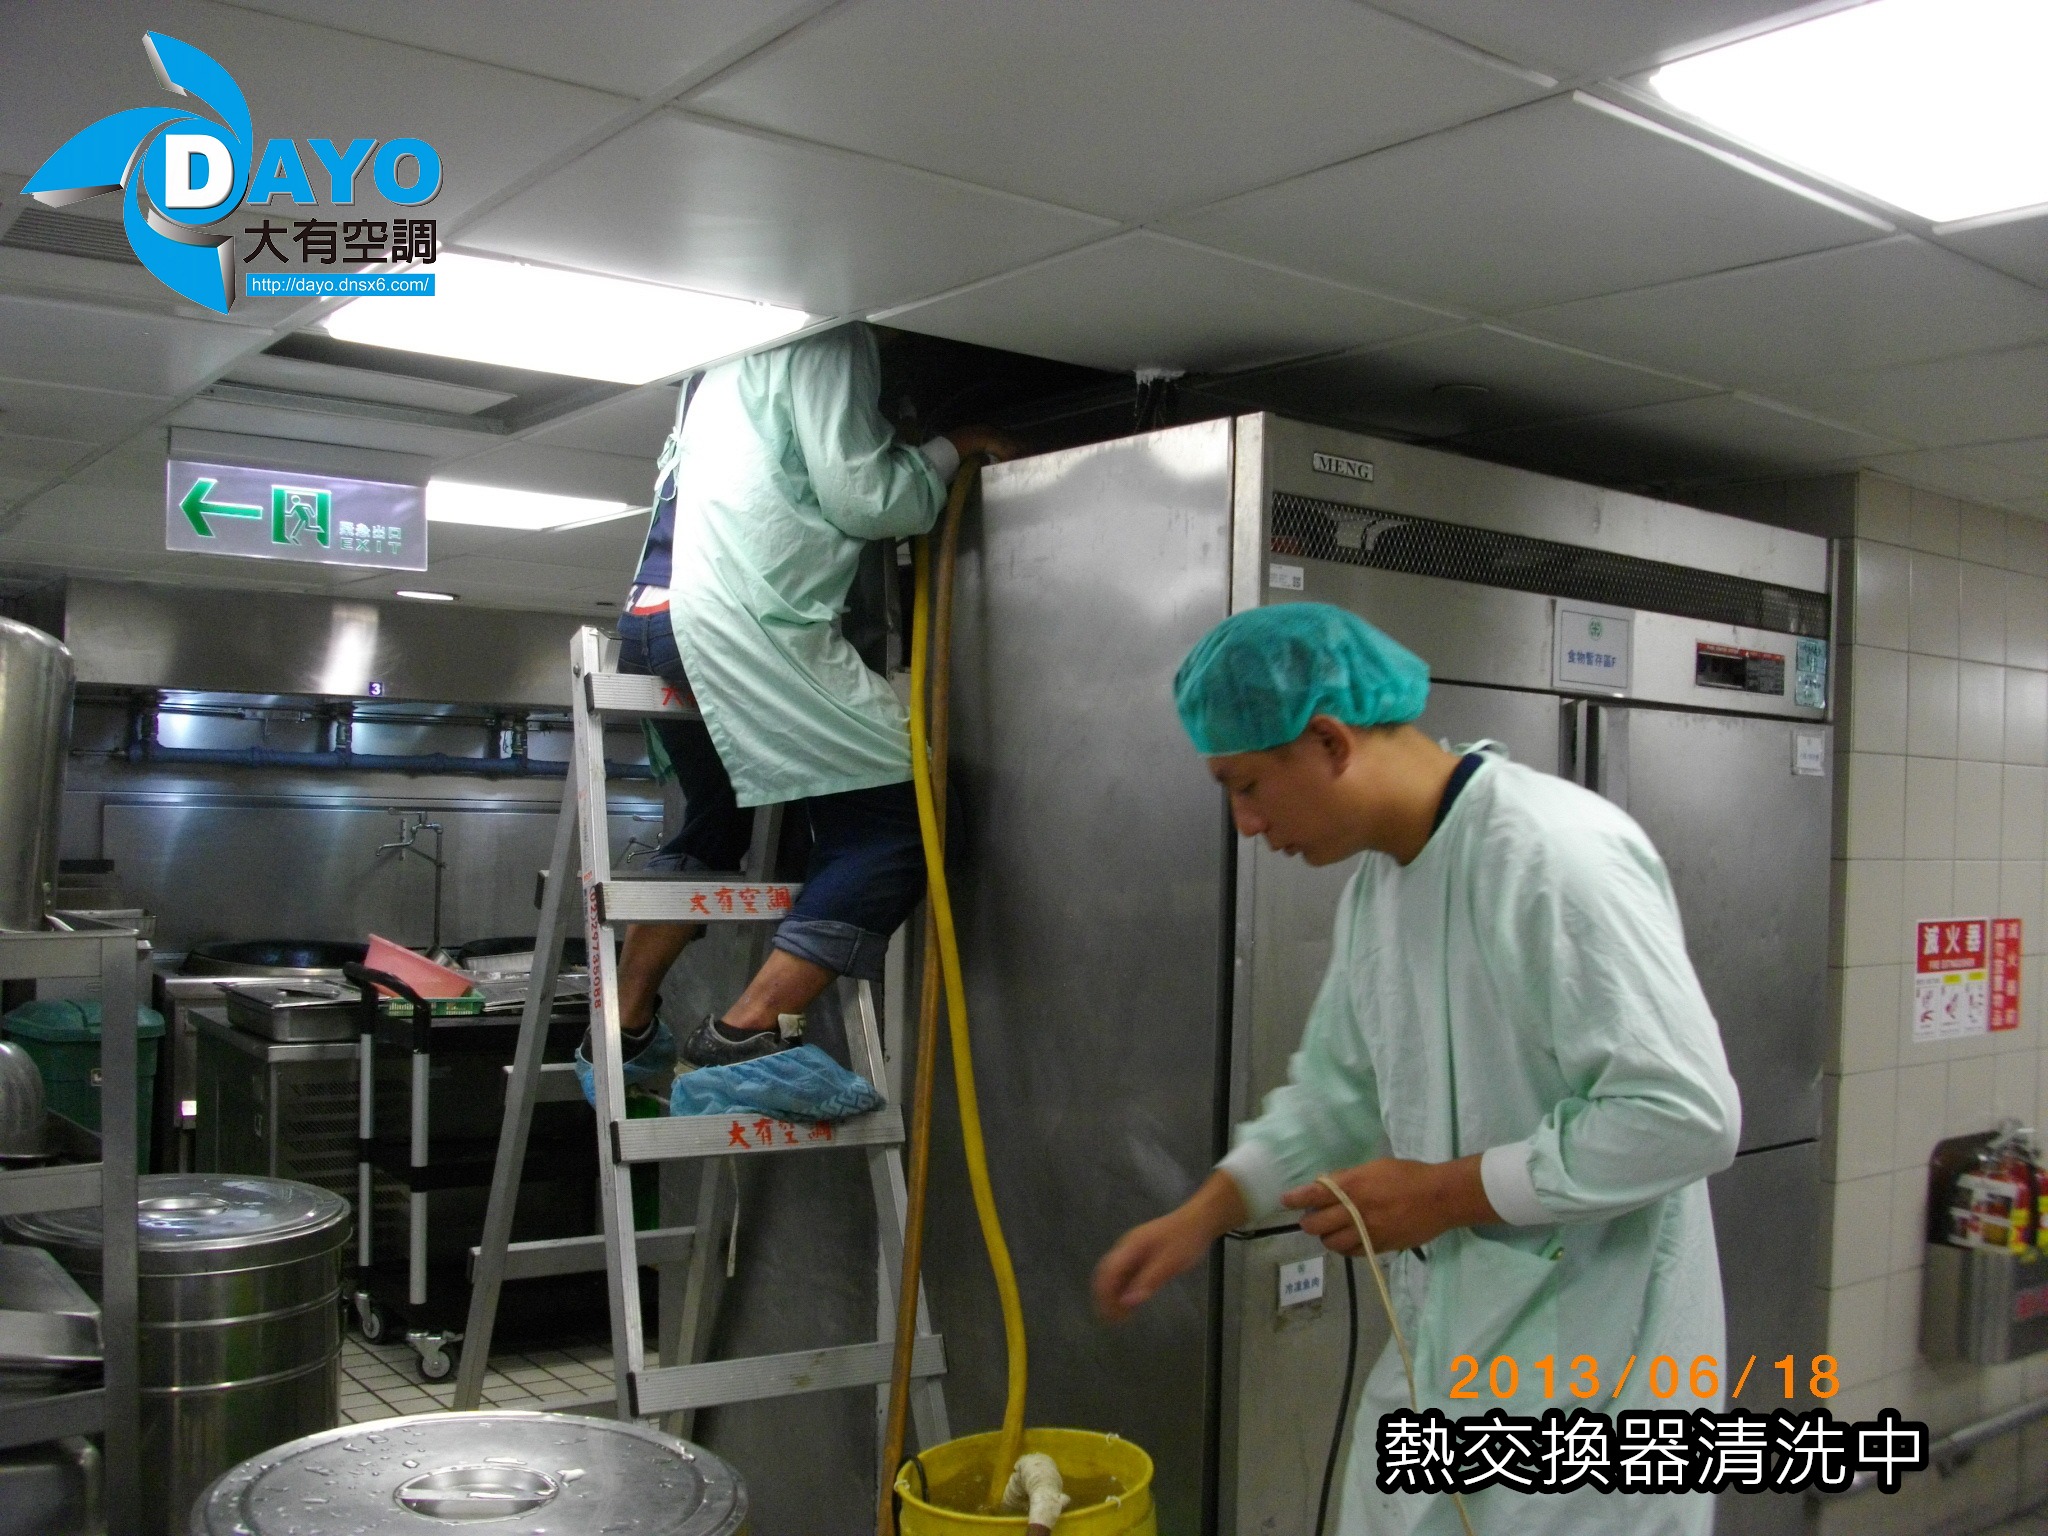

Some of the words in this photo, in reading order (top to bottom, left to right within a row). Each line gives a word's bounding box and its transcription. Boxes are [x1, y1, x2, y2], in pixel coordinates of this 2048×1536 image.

[1319, 456, 1369, 479] MENG
[340, 537, 401, 554] EXIT
[690, 886, 793, 915] 大有空調
